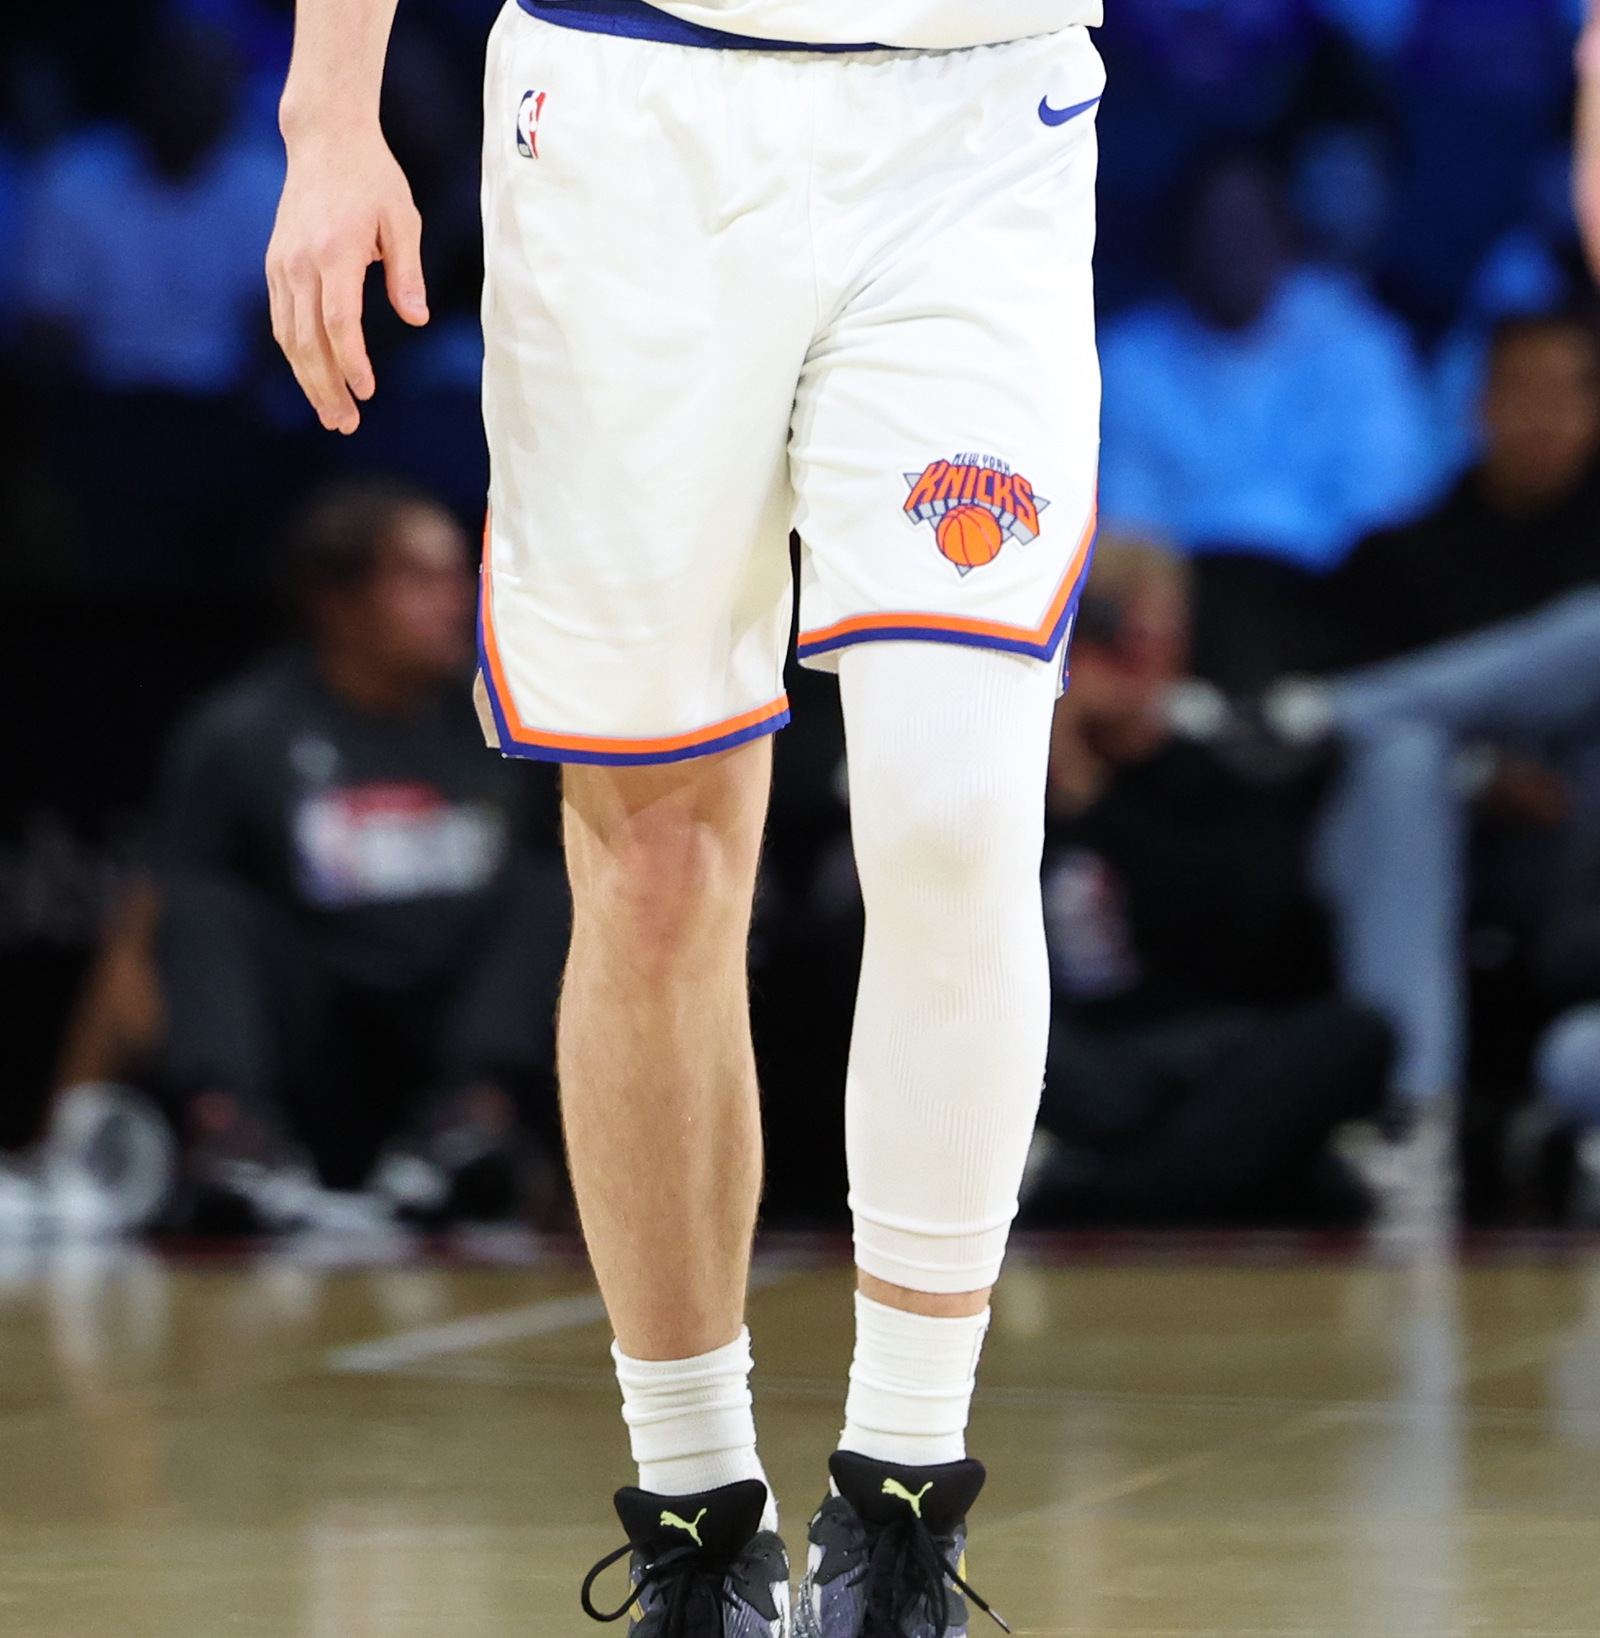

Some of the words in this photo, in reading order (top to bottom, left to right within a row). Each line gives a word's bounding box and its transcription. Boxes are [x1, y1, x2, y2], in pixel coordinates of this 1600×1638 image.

[952, 452, 980, 466] NEW
[982, 455, 1012, 476] YORK
[903, 458, 1040, 544] KNICKS
